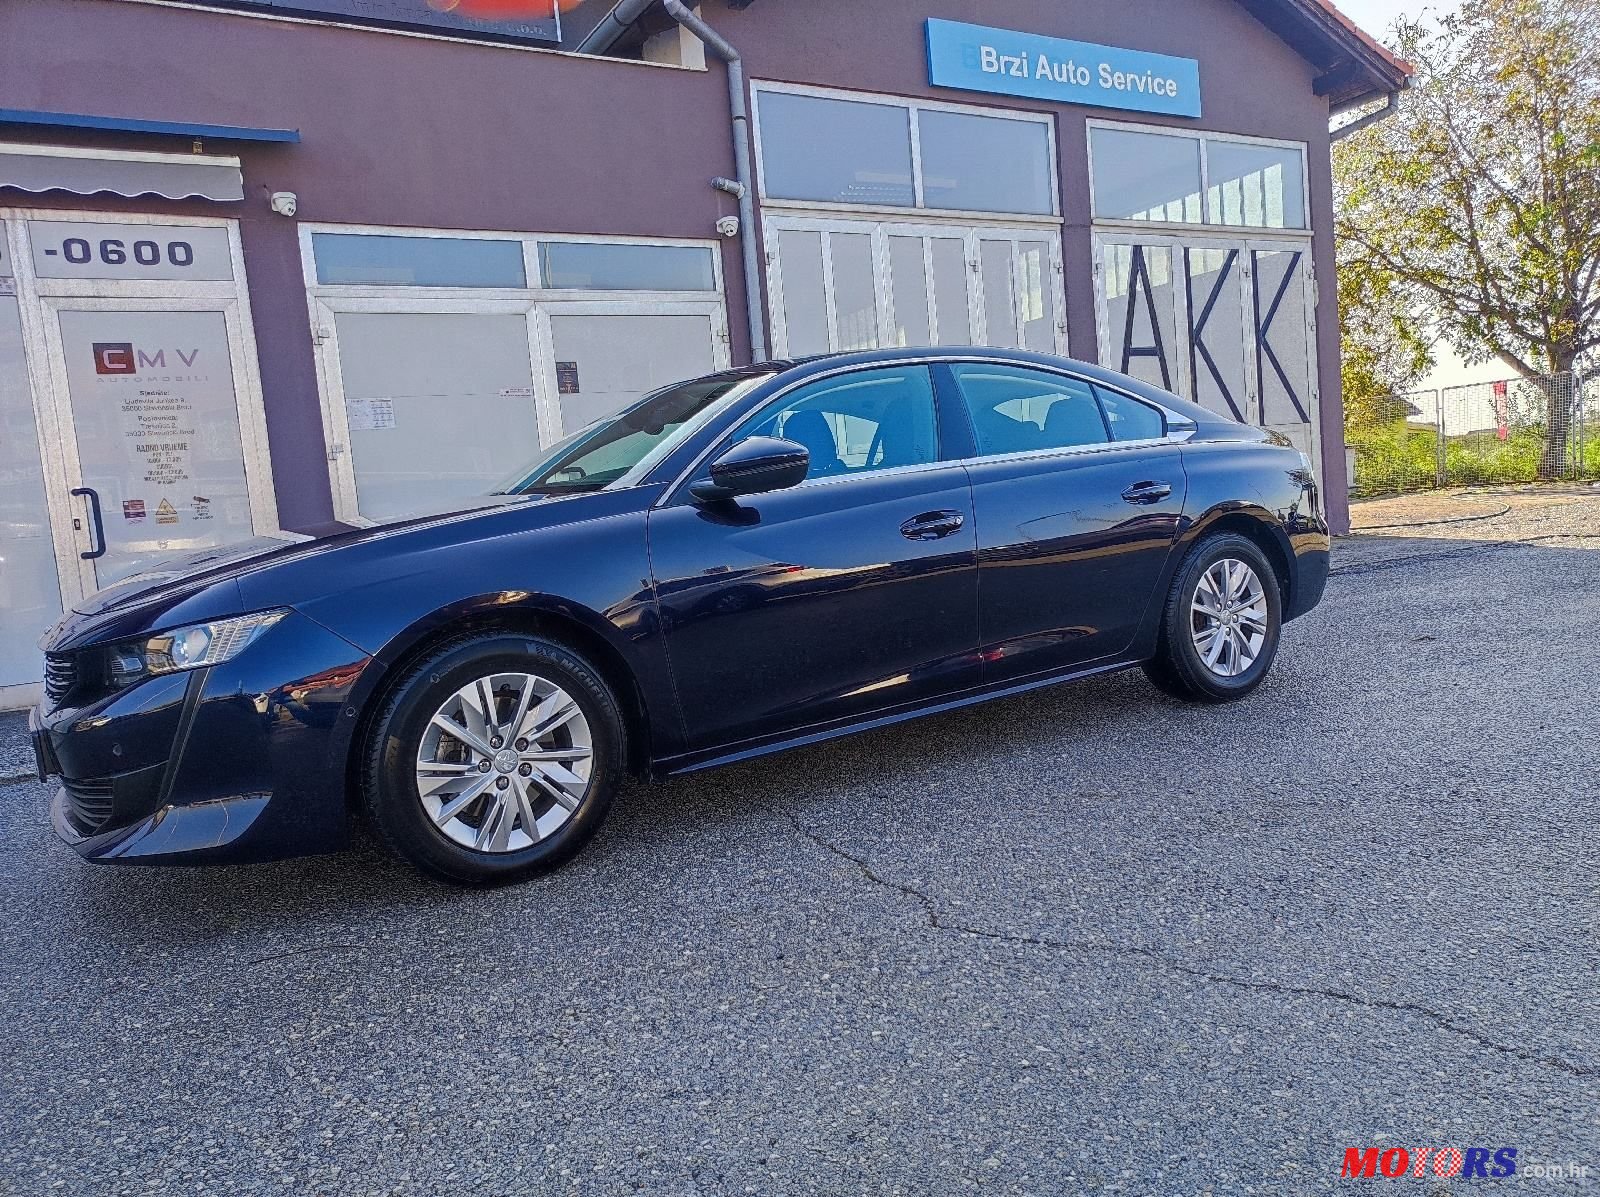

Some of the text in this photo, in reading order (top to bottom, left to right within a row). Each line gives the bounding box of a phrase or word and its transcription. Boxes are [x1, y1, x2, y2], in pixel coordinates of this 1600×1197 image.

[979, 44, 1178, 97] Brzi Auto Service
[103, 349, 199, 369] CMV
[96, 375, 209, 383] AUTOMOBILI
